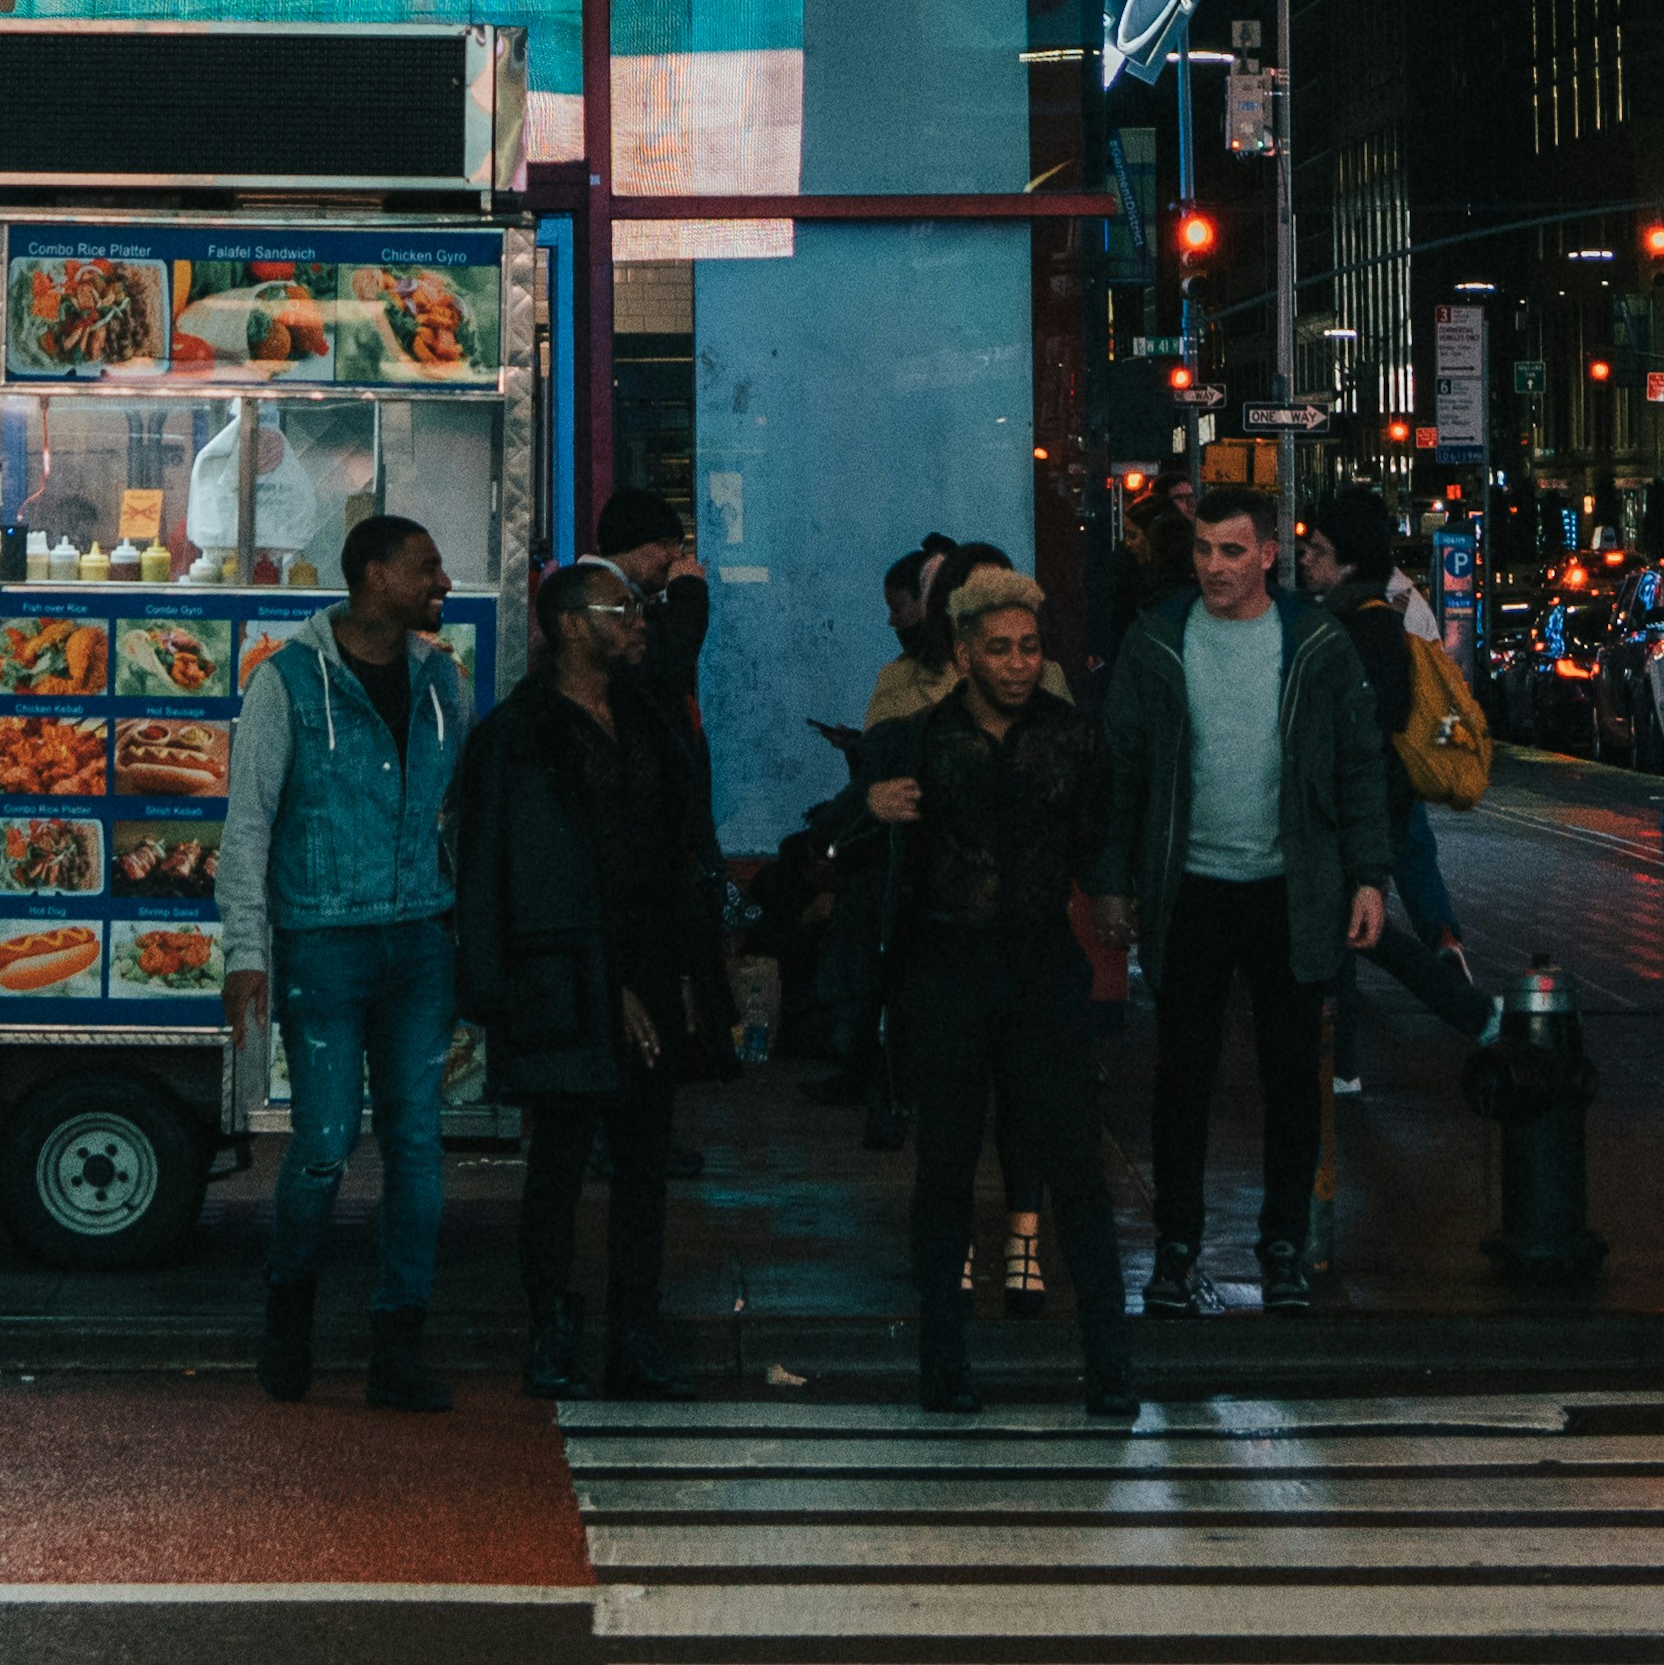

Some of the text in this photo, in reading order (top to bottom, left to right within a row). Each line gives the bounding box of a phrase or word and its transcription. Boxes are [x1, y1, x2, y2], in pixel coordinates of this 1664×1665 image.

[27, 242, 152, 259] Combo Rice Platter
[207, 244, 316, 261] Falafel Sandwich
[381, 247, 467, 265] Chicken Gyro
[1440, 308, 1448, 323] 3
[1441, 381, 1448, 394] 6
[1195, 390, 1216, 401] WAY
[1252, 411, 1318, 423] ONE WAY
[1455, 552, 1468, 575] P
[22, 602, 88, 613] Fish over Rice
[145, 604, 203, 616] Combo Gyro
[258, 605, 312, 617] Shrimp over
[15, 703, 84, 715] Chicken Kebab
[166, 706, 205, 718] Sausage
[4, 803, 91, 815] Combo Rice Platter
[173, 805, 203, 816] Kebab
[138, 906, 199, 919] Shrimp Salad
